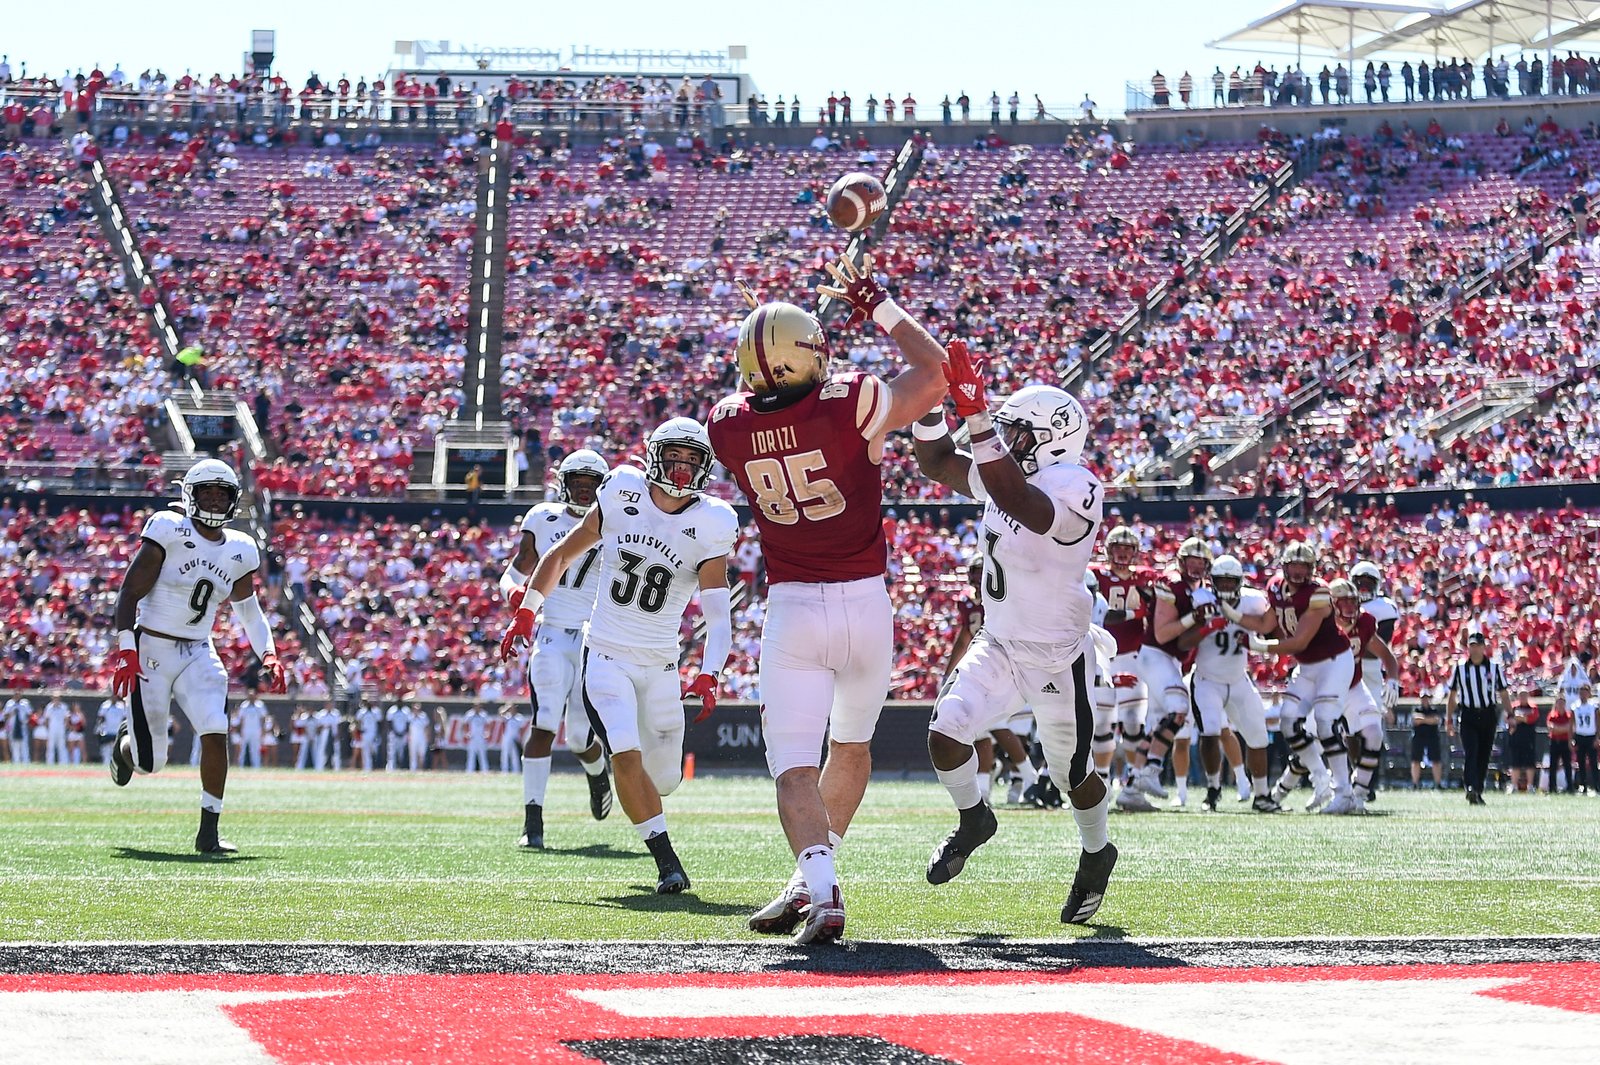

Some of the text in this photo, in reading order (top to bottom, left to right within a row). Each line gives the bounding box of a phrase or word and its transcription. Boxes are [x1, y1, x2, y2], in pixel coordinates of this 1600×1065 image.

[751, 425, 798, 456] IDRIZI
[744, 448, 847, 526] 85
[1082, 480, 1098, 510] 3
[617, 533, 684, 570] LOUISVILLE
[984, 523, 1008, 603] 3
[186, 576, 216, 627] 9
[608, 547, 676, 615] 38
[717, 723, 760, 748] SUN
